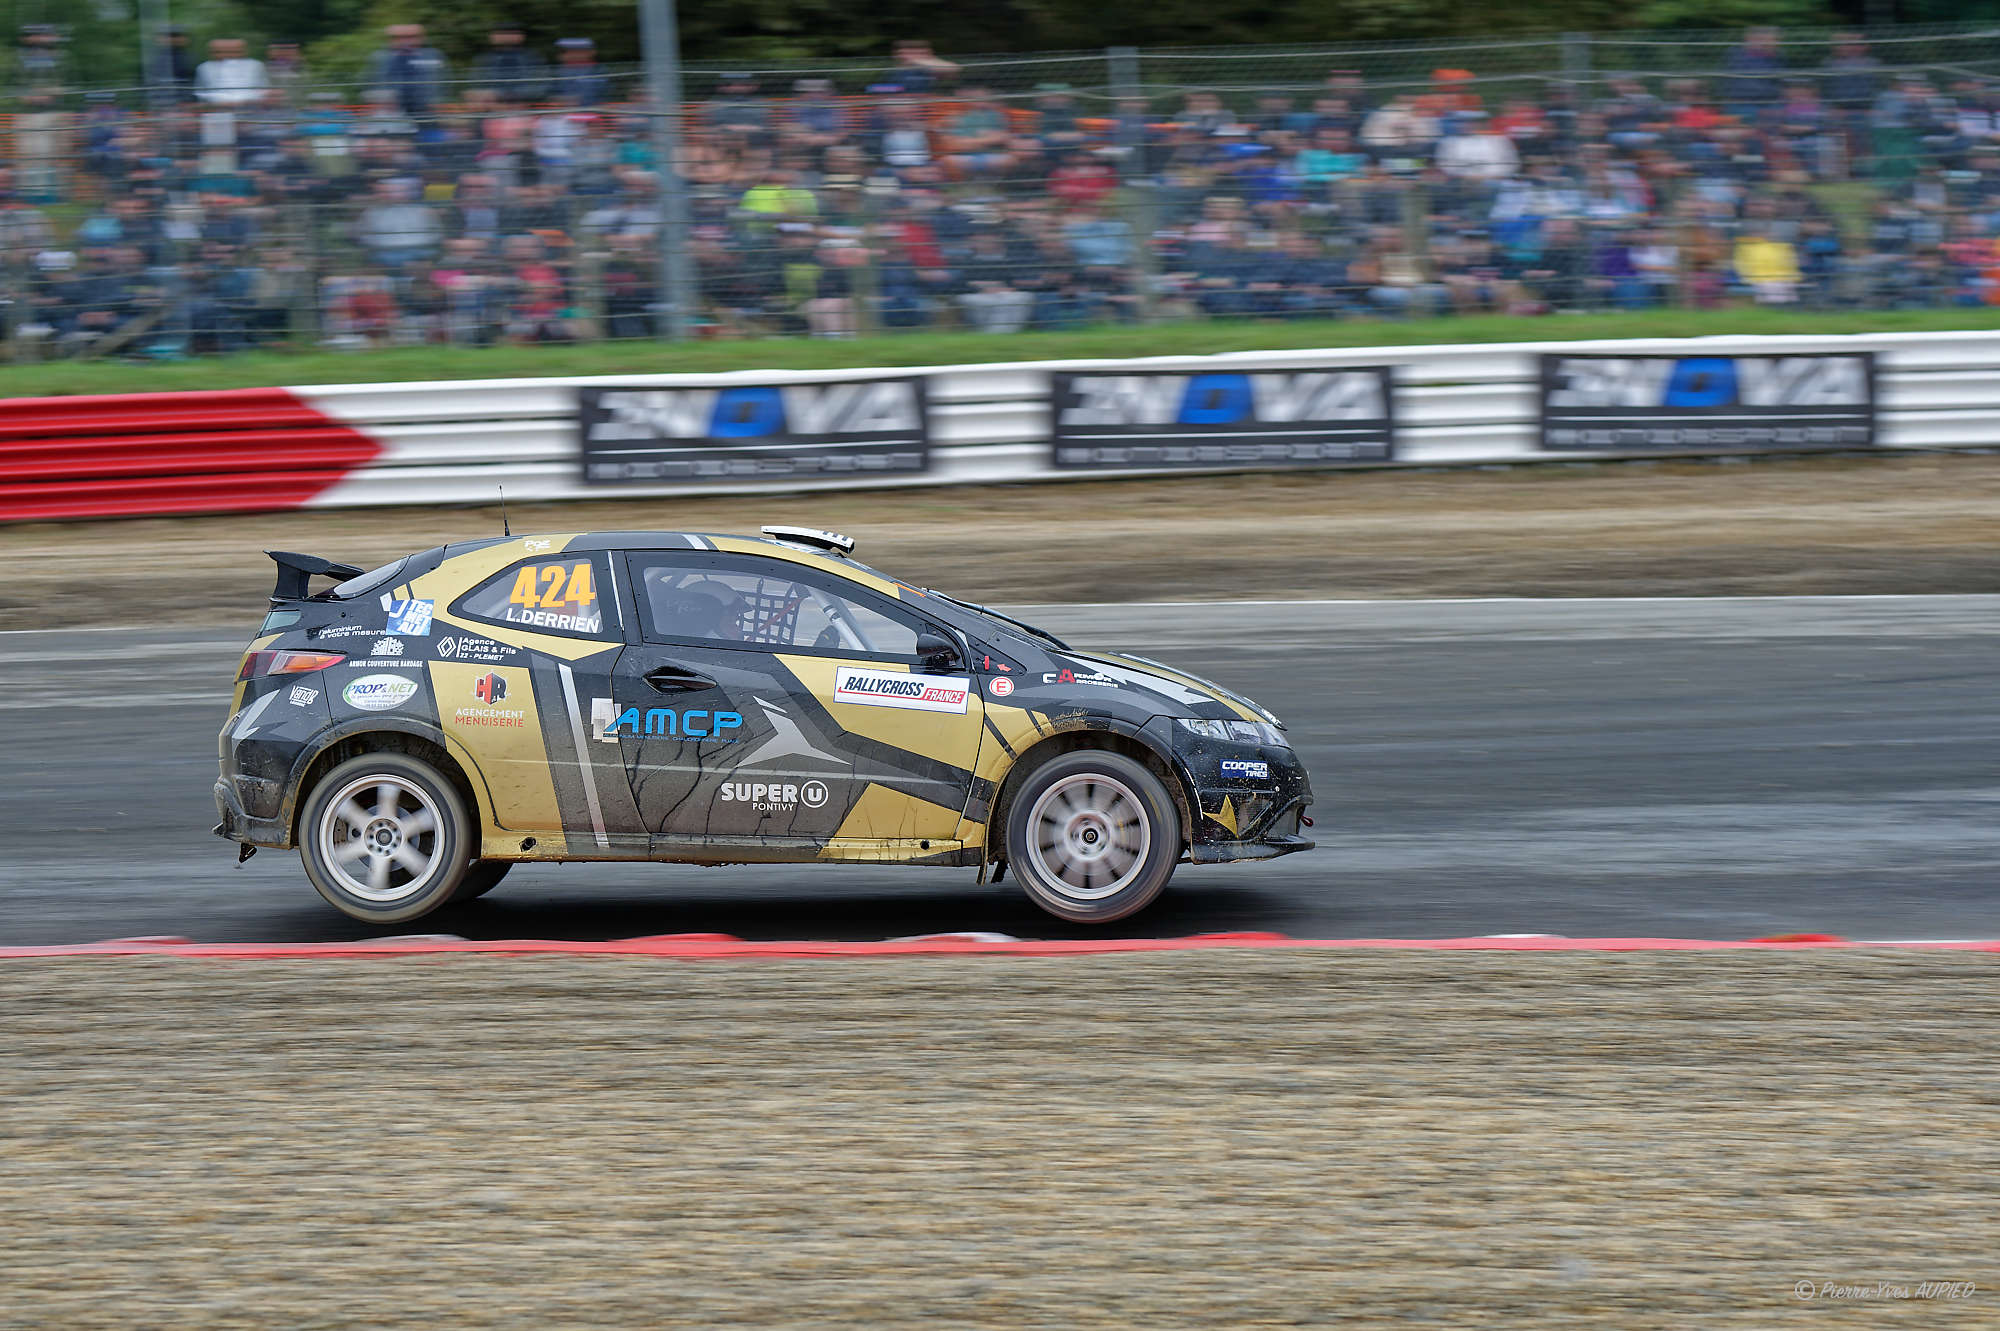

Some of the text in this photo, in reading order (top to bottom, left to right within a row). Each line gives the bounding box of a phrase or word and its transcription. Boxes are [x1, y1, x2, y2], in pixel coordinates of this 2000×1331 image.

[510, 564, 596, 609] 424
[506, 608, 600, 633] L.DERRIEN
[462, 637, 495, 646] Agence
[461, 644, 489, 653] GLAIS
[500, 647, 517, 655] Fils
[473, 653, 504, 661] PLEMET
[844, 676, 965, 704] RALLYCROSS FRANCE
[455, 708, 525, 718] AGENCEMENT
[455, 716, 525, 728] MENUISERIE
[602, 707, 743, 737] AMCP
[1222, 761, 1268, 772] COOPER
[1245, 770, 1268, 778] TIRES
[721, 782, 798, 803] SUPER
[752, 802, 795, 811] PONTIVY
